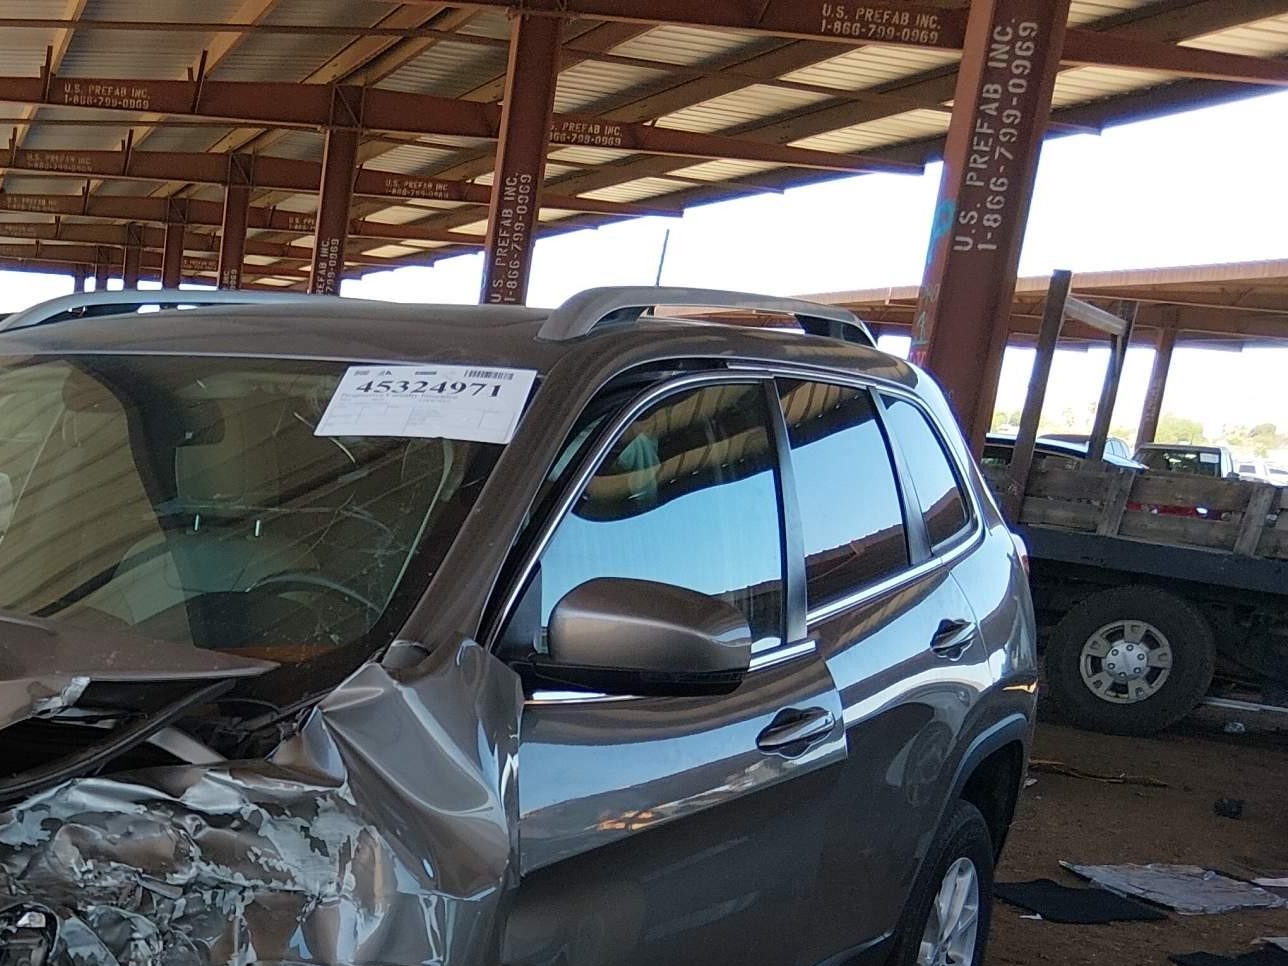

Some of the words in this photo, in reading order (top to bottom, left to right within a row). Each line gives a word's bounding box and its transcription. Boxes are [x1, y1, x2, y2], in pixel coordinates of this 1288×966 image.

[821, 19, 938, 44] 1-866-799-0969
[822, 3, 848, 19] U.S.
[856, 7, 909, 25] PREFAB
[916, 14, 941, 29] INC.
[988, 18, 1016, 68] INC.
[88, 84, 127, 98] PREFAB
[563, 122, 600, 135] PREFAB
[966, 83, 1002, 187] PREFAB
[977, 21, 1038, 251] 1-866-799-0969
[495, 208, 514, 267] PREFAB
[504, 174, 533, 303] 1-866-799-0969
[954, 203, 980, 251] U.S.
[316, 262, 328, 296] REFAB
[490, 274, 505, 303] U.S.
[355, 380, 503, 398] 45324971
